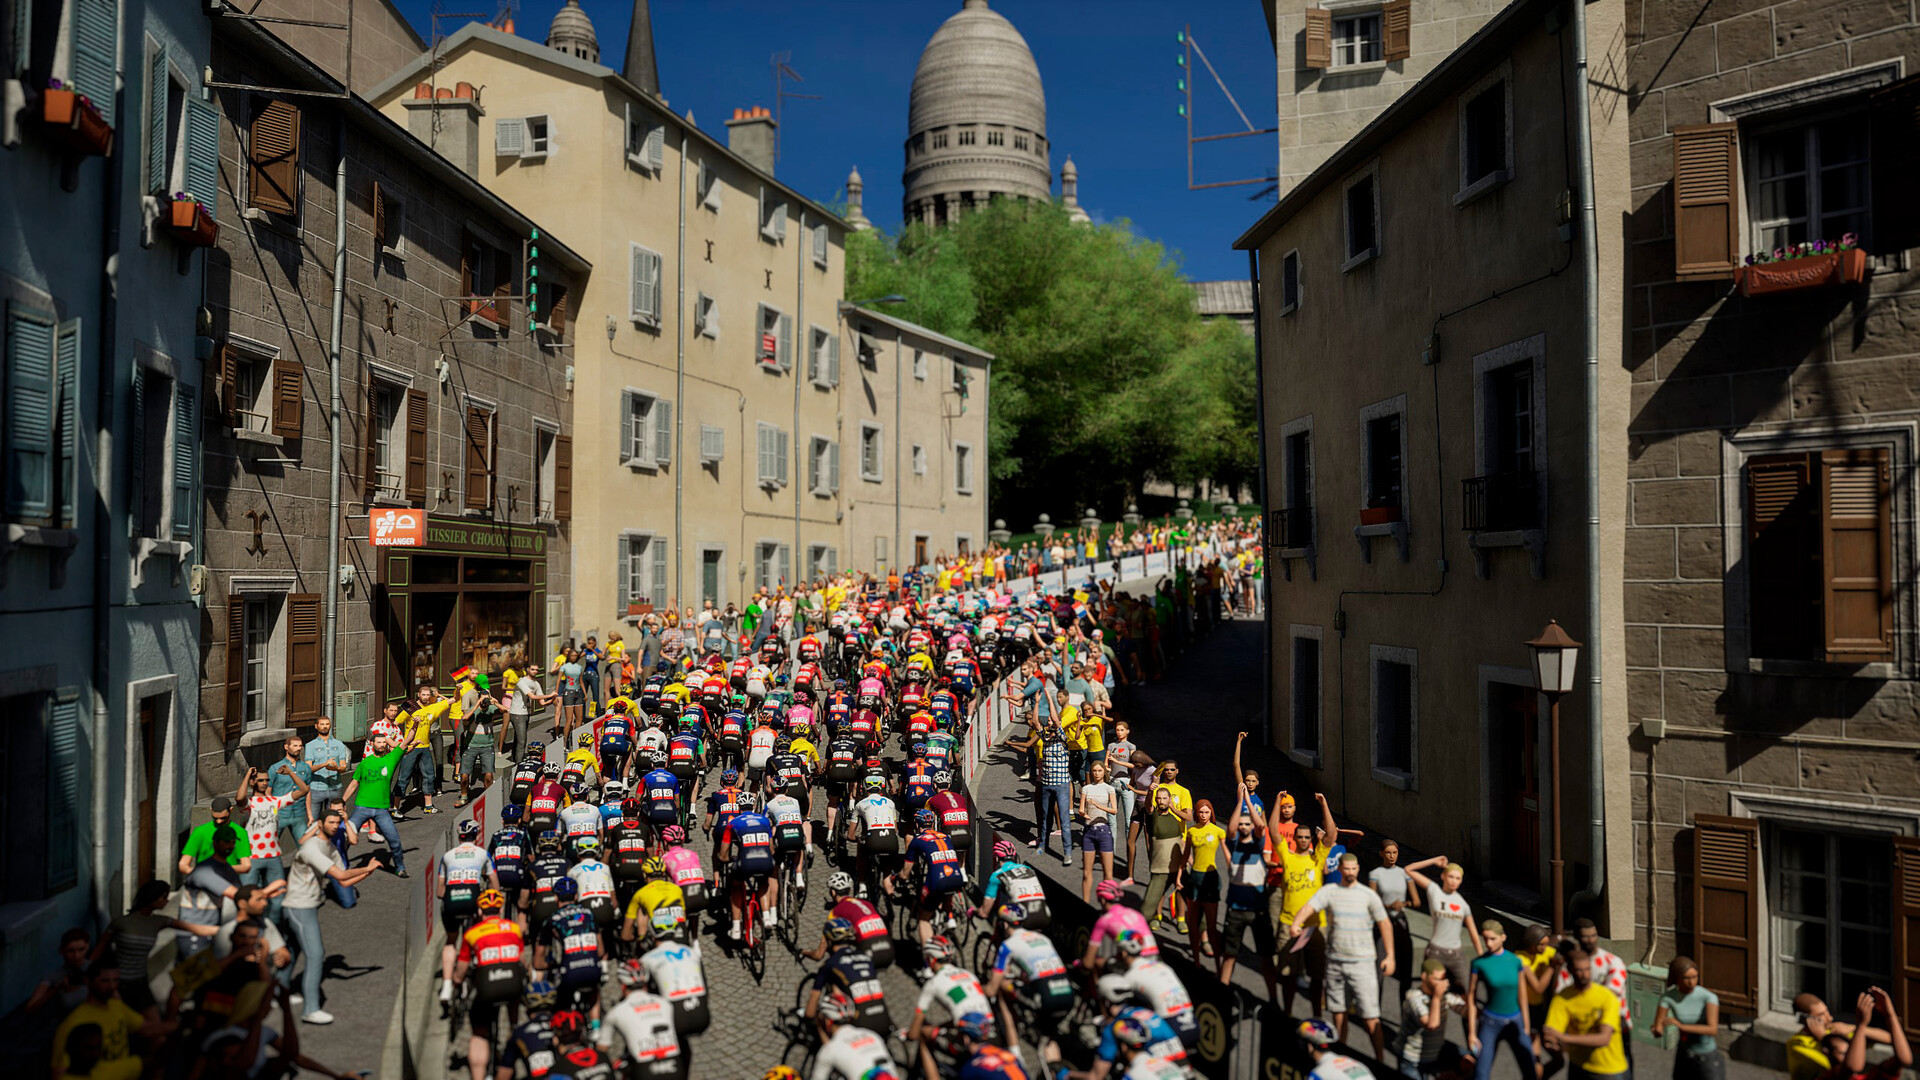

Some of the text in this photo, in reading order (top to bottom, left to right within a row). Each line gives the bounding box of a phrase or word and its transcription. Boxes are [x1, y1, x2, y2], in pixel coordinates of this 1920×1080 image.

[375, 537, 415, 545] BOULANGER
[426, 527, 533, 549] TISSIER CHOCOLATIER
[1203, 1021, 1217, 1040] 21
